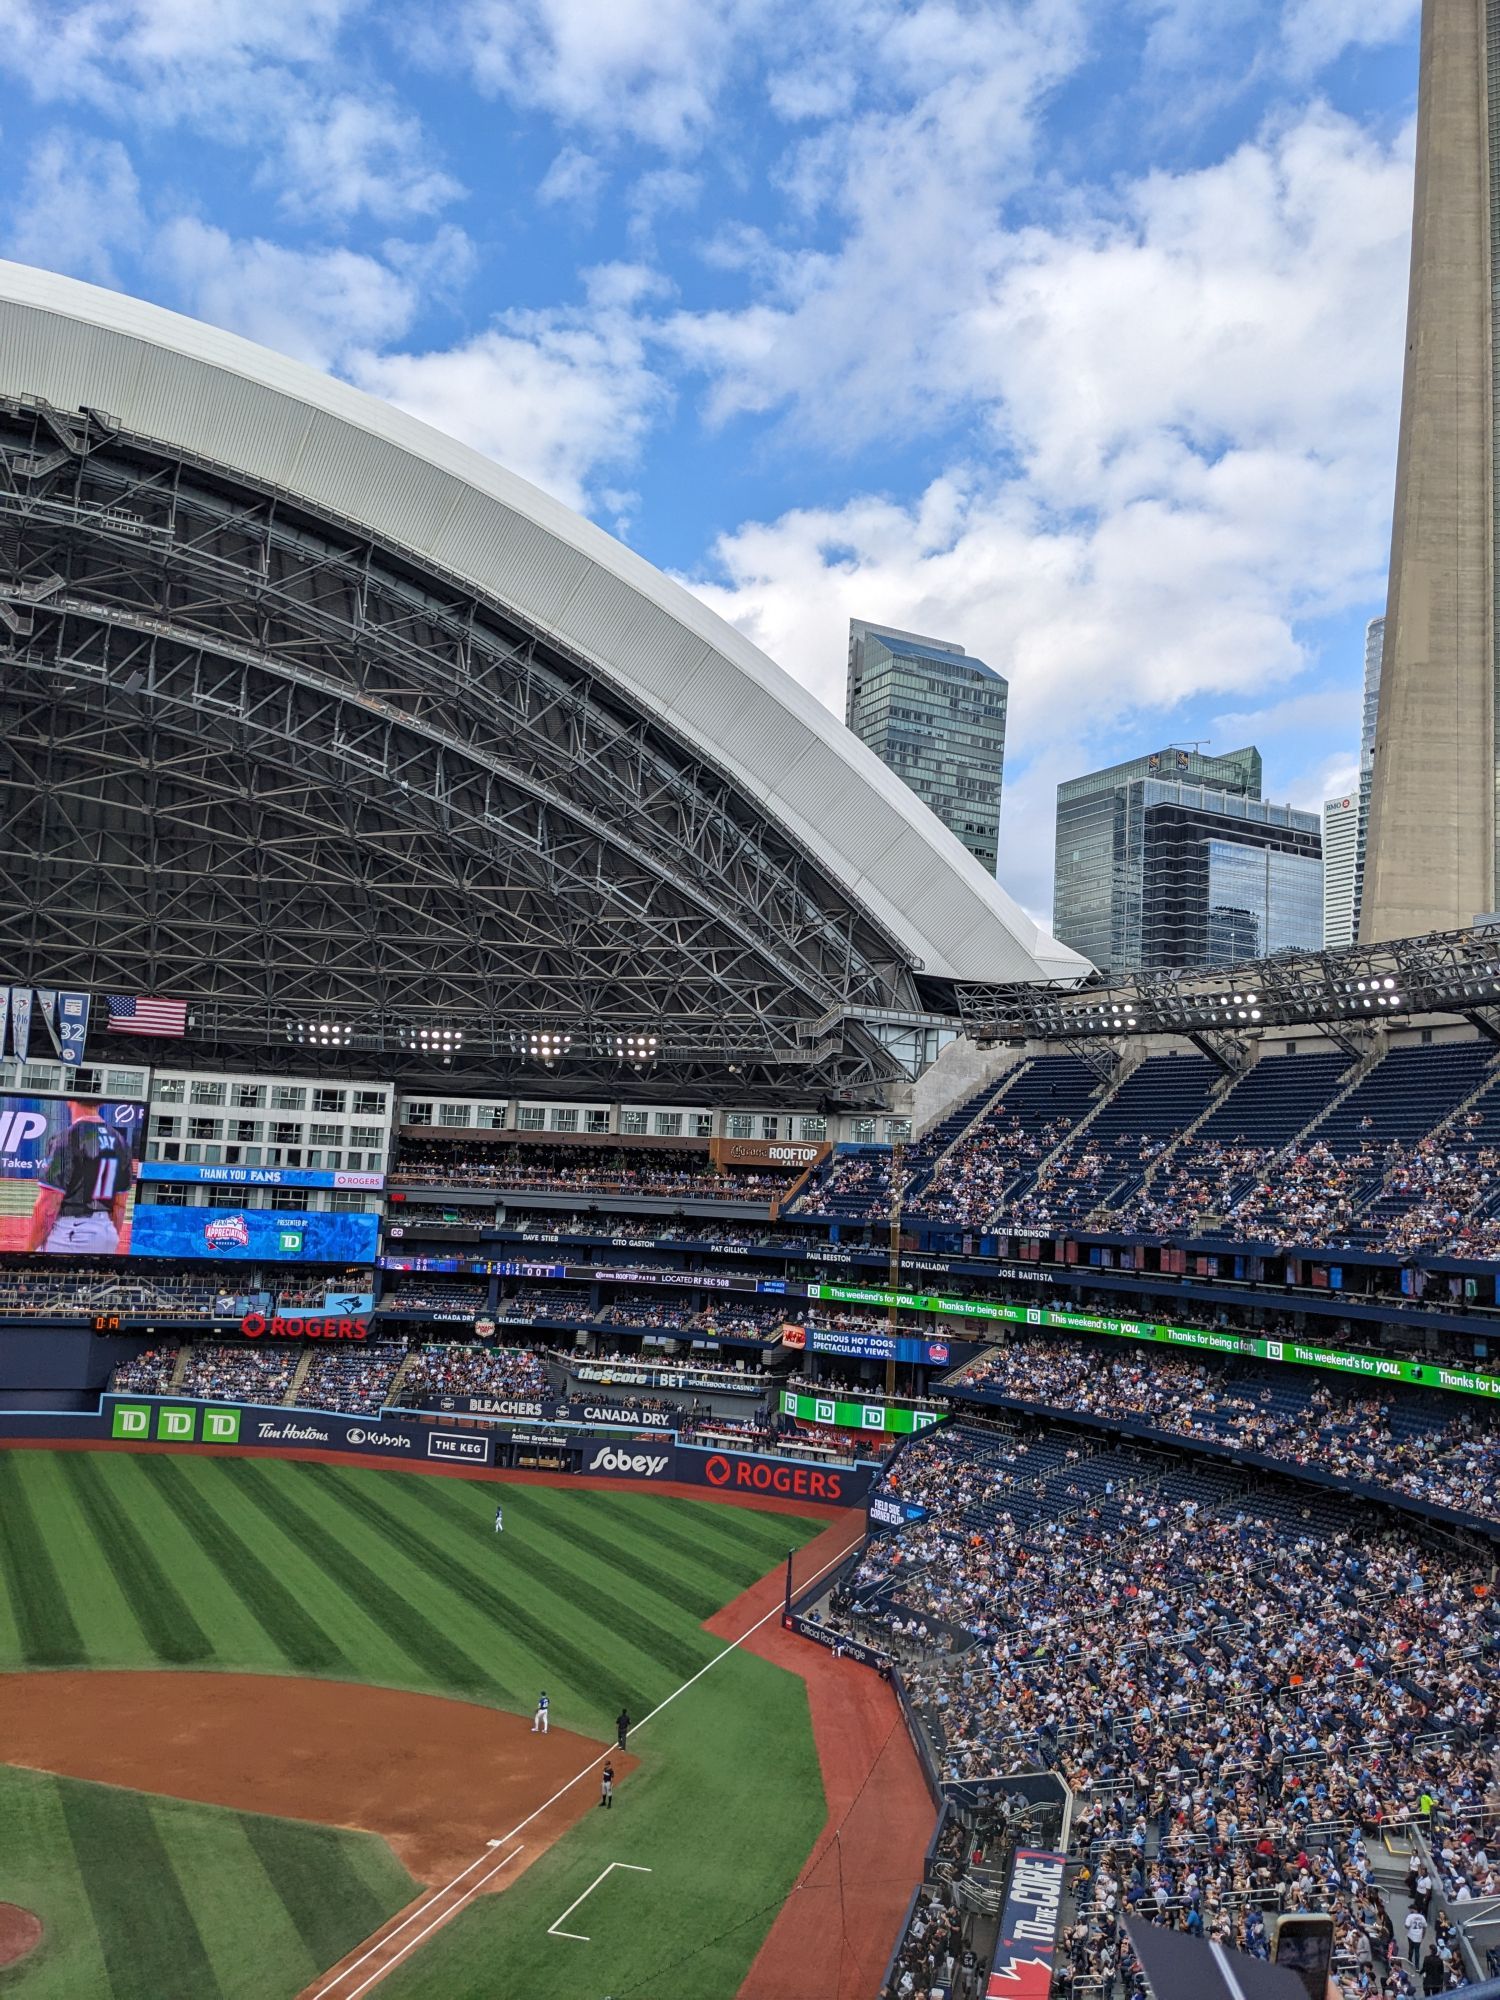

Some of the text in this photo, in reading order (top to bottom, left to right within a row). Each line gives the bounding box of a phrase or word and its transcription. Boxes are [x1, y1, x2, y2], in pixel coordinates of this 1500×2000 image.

[60, 1022, 85, 1041] 32
[769, 1148, 817, 1160] ROOFTOP
[3, 1158, 32, 1168] Takes
[200, 1169, 280, 1182] THANK YOU FANS
[207, 1227, 247, 1242] APPRECIATION
[990, 1228, 1012, 1236] JACKIE
[1014, 1229, 1050, 1238] ROBINSON
[282, 1235, 300, 1248] TD
[628, 1240, 654, 1248] GASTON
[724, 1246, 748, 1254] GILLICK
[822, 1254, 850, 1262] BEESTON
[901, 1260, 914, 1268] ROY
[916, 1262, 950, 1272] HALLADAY
[662, 1275, 692, 1284] LOCATED
[716, 1279, 730, 1287] 508
[998, 1269, 1053, 1282] JOSÉ BAUTISTA
[810, 1286, 818, 1294] TD
[830, 1288, 914, 1306] This weekend's for you.
[938, 1300, 964, 1312] Thanks
[965, 1304, 976, 1312] for
[976, 1306, 998, 1316] being
[1004, 1310, 1018, 1318] fan.
[1030, 1312, 1038, 1320] TD
[96, 1317, 118, 1328] 0:19
[271, 1317, 368, 1339] ROGERS
[498, 1317, 532, 1325] BLEACHERS
[1050, 1314, 1140, 1334] This weekend's for you.
[814, 1332, 896, 1348] DELICIOUS HOT DOGS.
[1167, 1330, 1196, 1342] Thanks
[1197, 1334, 1208, 1344] for
[1209, 1336, 1232, 1350] being
[1240, 1340, 1256, 1352] fan.
[813, 1342, 892, 1357] SPECTACULAR VIEWS.
[1270, 1346, 1280, 1356] TD
[1294, 1348, 1401, 1375] This weekend's for you.
[578, 1368, 647, 1384] theScore
[660, 1374, 685, 1388] BET
[688, 1380, 726, 1388] SPORTSBOOK
[1439, 1372, 1474, 1389] Thanks
[1476, 1377, 1490, 1392] for
[470, 1398, 542, 1416] BLEACHERS
[788, 1398, 794, 1410] TD
[584, 1408, 640, 1423] CANADA
[819, 1406, 832, 1418] TD
[867, 1412, 880, 1424] TD
[118, 1410, 146, 1432] TD
[163, 1413, 192, 1434] TD
[208, 1414, 236, 1436] TD
[258, 1423, 328, 1441] Tim Hortons
[368, 1432, 411, 1448] Kubota
[436, 1440, 481, 1453] THE KEG
[590, 1446, 668, 1476] Sobeys
[736, 1462, 842, 1499] ROGERS
[870, 1508, 890, 1522] CORNER
[874, 1499, 888, 1512] FIELD
[888, 1504, 900, 1516] SIDE
[800, 1623, 820, 1639] Official
[1010, 1858, 1064, 1942] TO THE CORE
